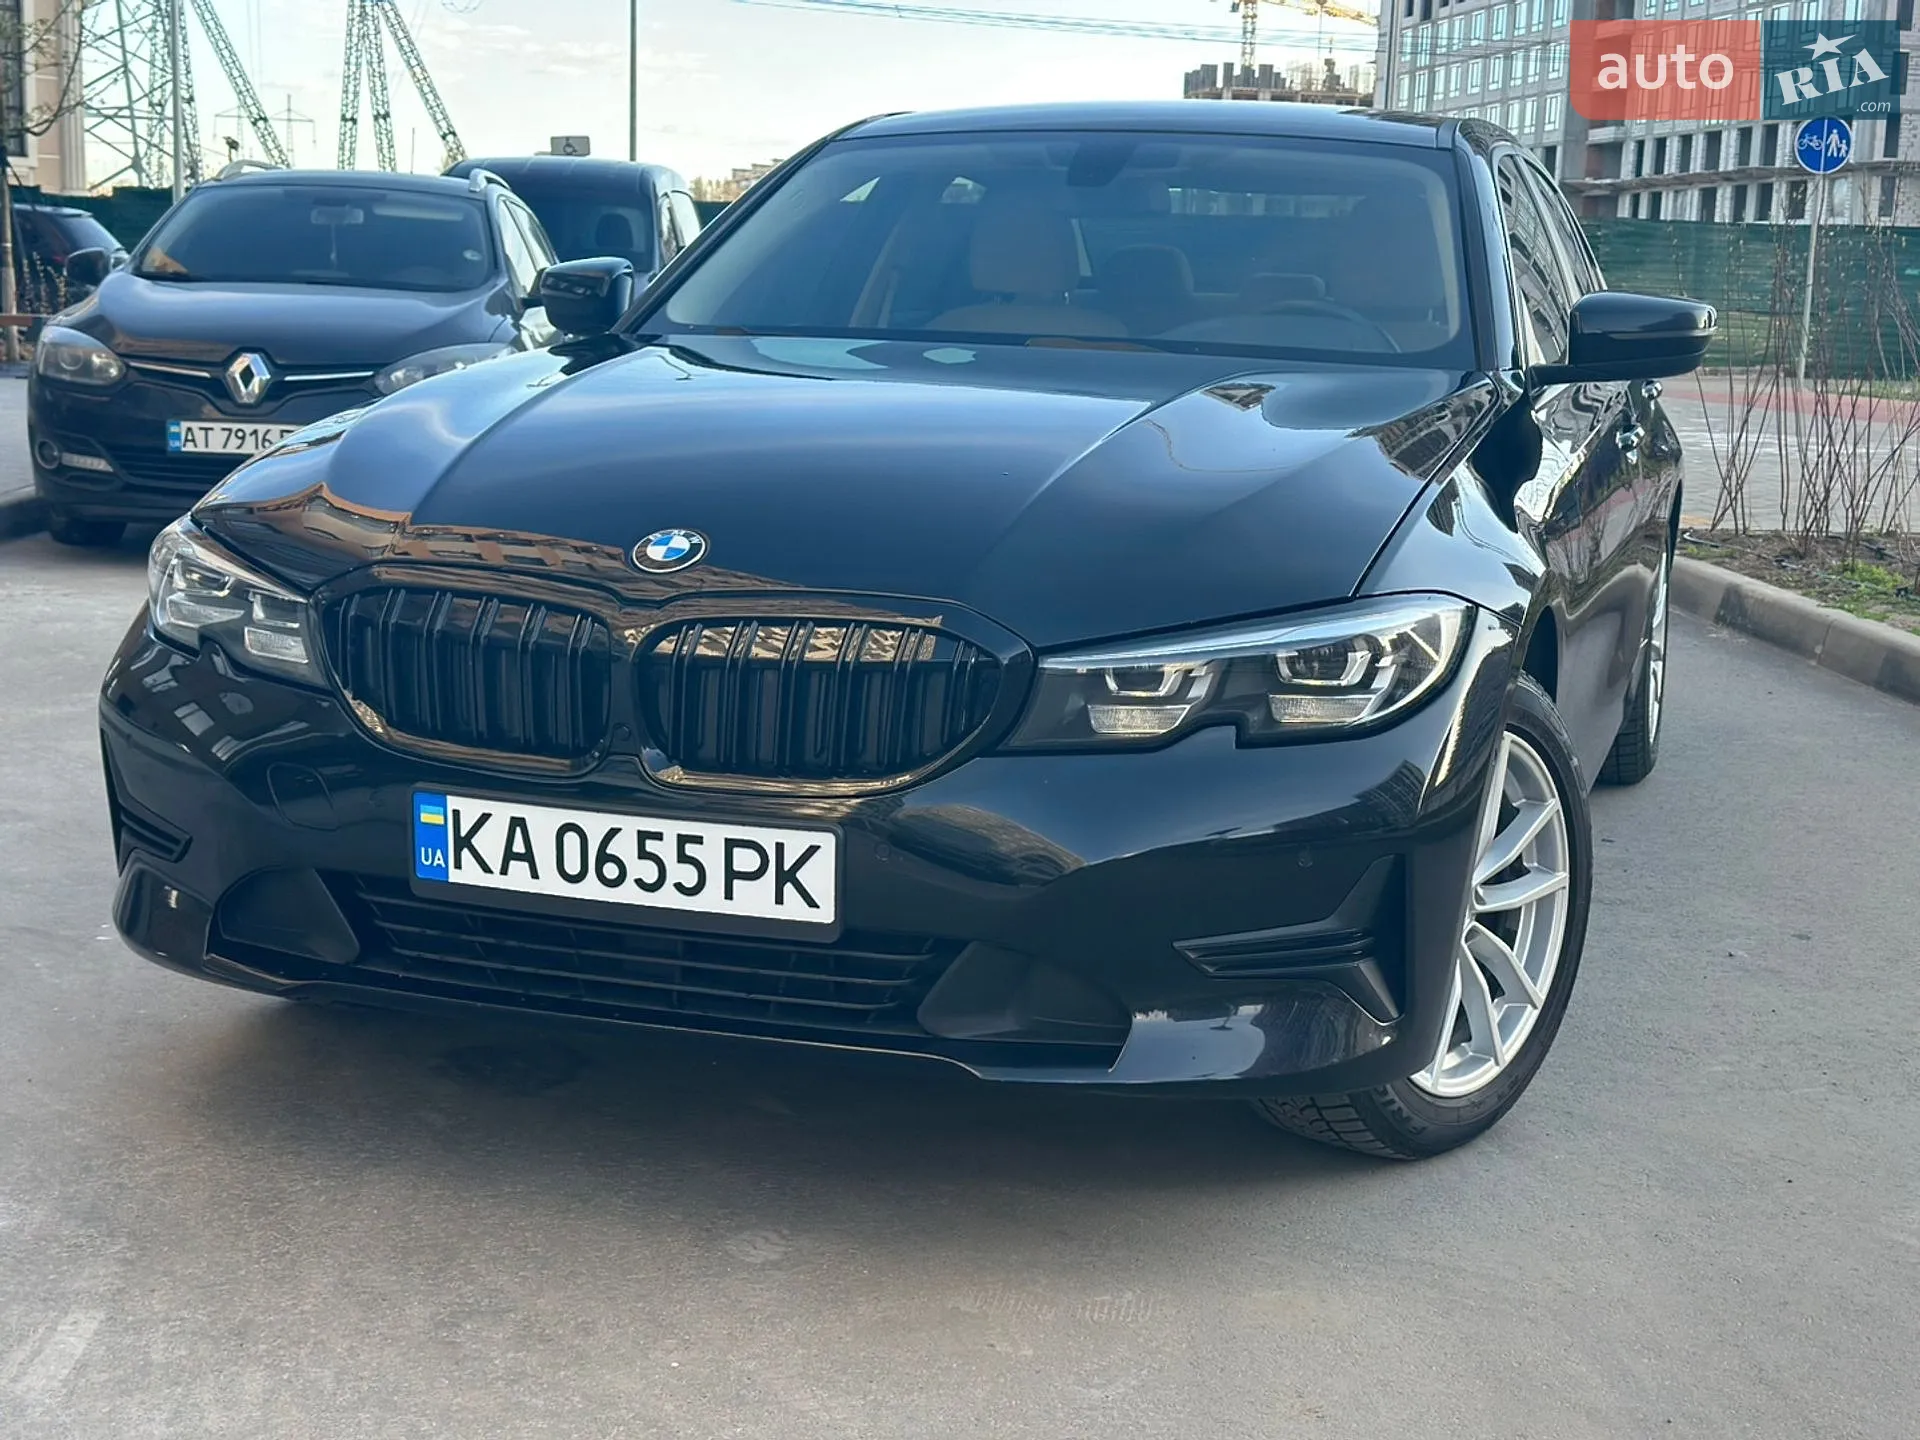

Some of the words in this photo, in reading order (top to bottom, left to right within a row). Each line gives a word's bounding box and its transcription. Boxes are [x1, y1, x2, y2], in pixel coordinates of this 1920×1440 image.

[182, 427, 214, 448] AT
[221, 428, 273, 450] 7916
[421, 847, 445, 868] UA
[452, 809, 540, 880] KA
[555, 822, 707, 897] 0655
[724, 837, 821, 909] PK
